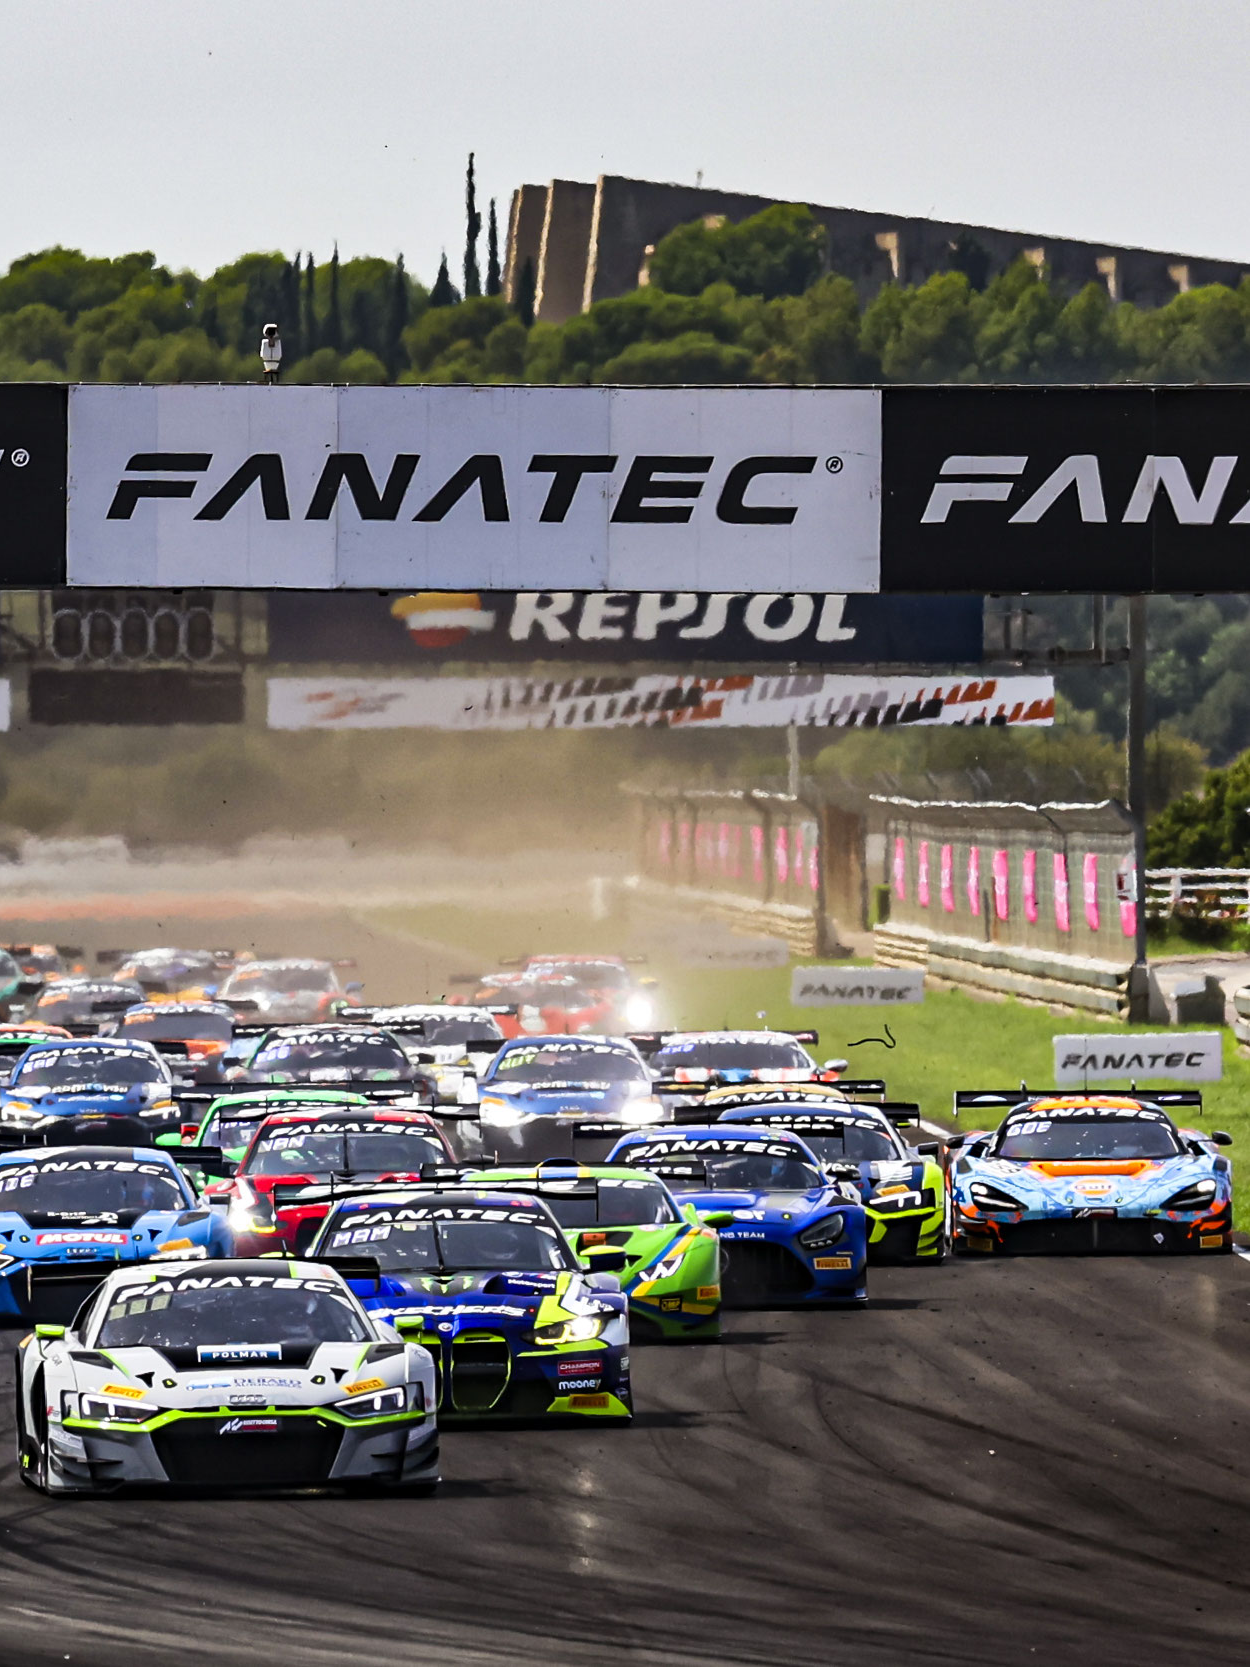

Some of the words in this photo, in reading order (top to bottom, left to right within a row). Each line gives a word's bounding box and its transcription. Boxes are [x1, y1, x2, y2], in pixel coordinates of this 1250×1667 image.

[920, 454, 1250, 525] FAN
[508, 593, 858, 643] REPSOL
[800, 984, 910, 1001] FANATEC
[1061, 1052, 1206, 1071] FANATEC
[1007, 1108, 1163, 1126] FANATEC
[268, 1123, 433, 1139] FANATEC
[628, 1139, 796, 1159] FANATEC
[340, 1208, 545, 1230] FANATEC
[39, 1233, 124, 1245] MOTUL
[117, 1276, 342, 1305] FANATEC
[212, 1350, 269, 1359] POLMAR
[559, 1361, 601, 1371] CHAMPION
[558, 1379, 602, 1391] mooney
